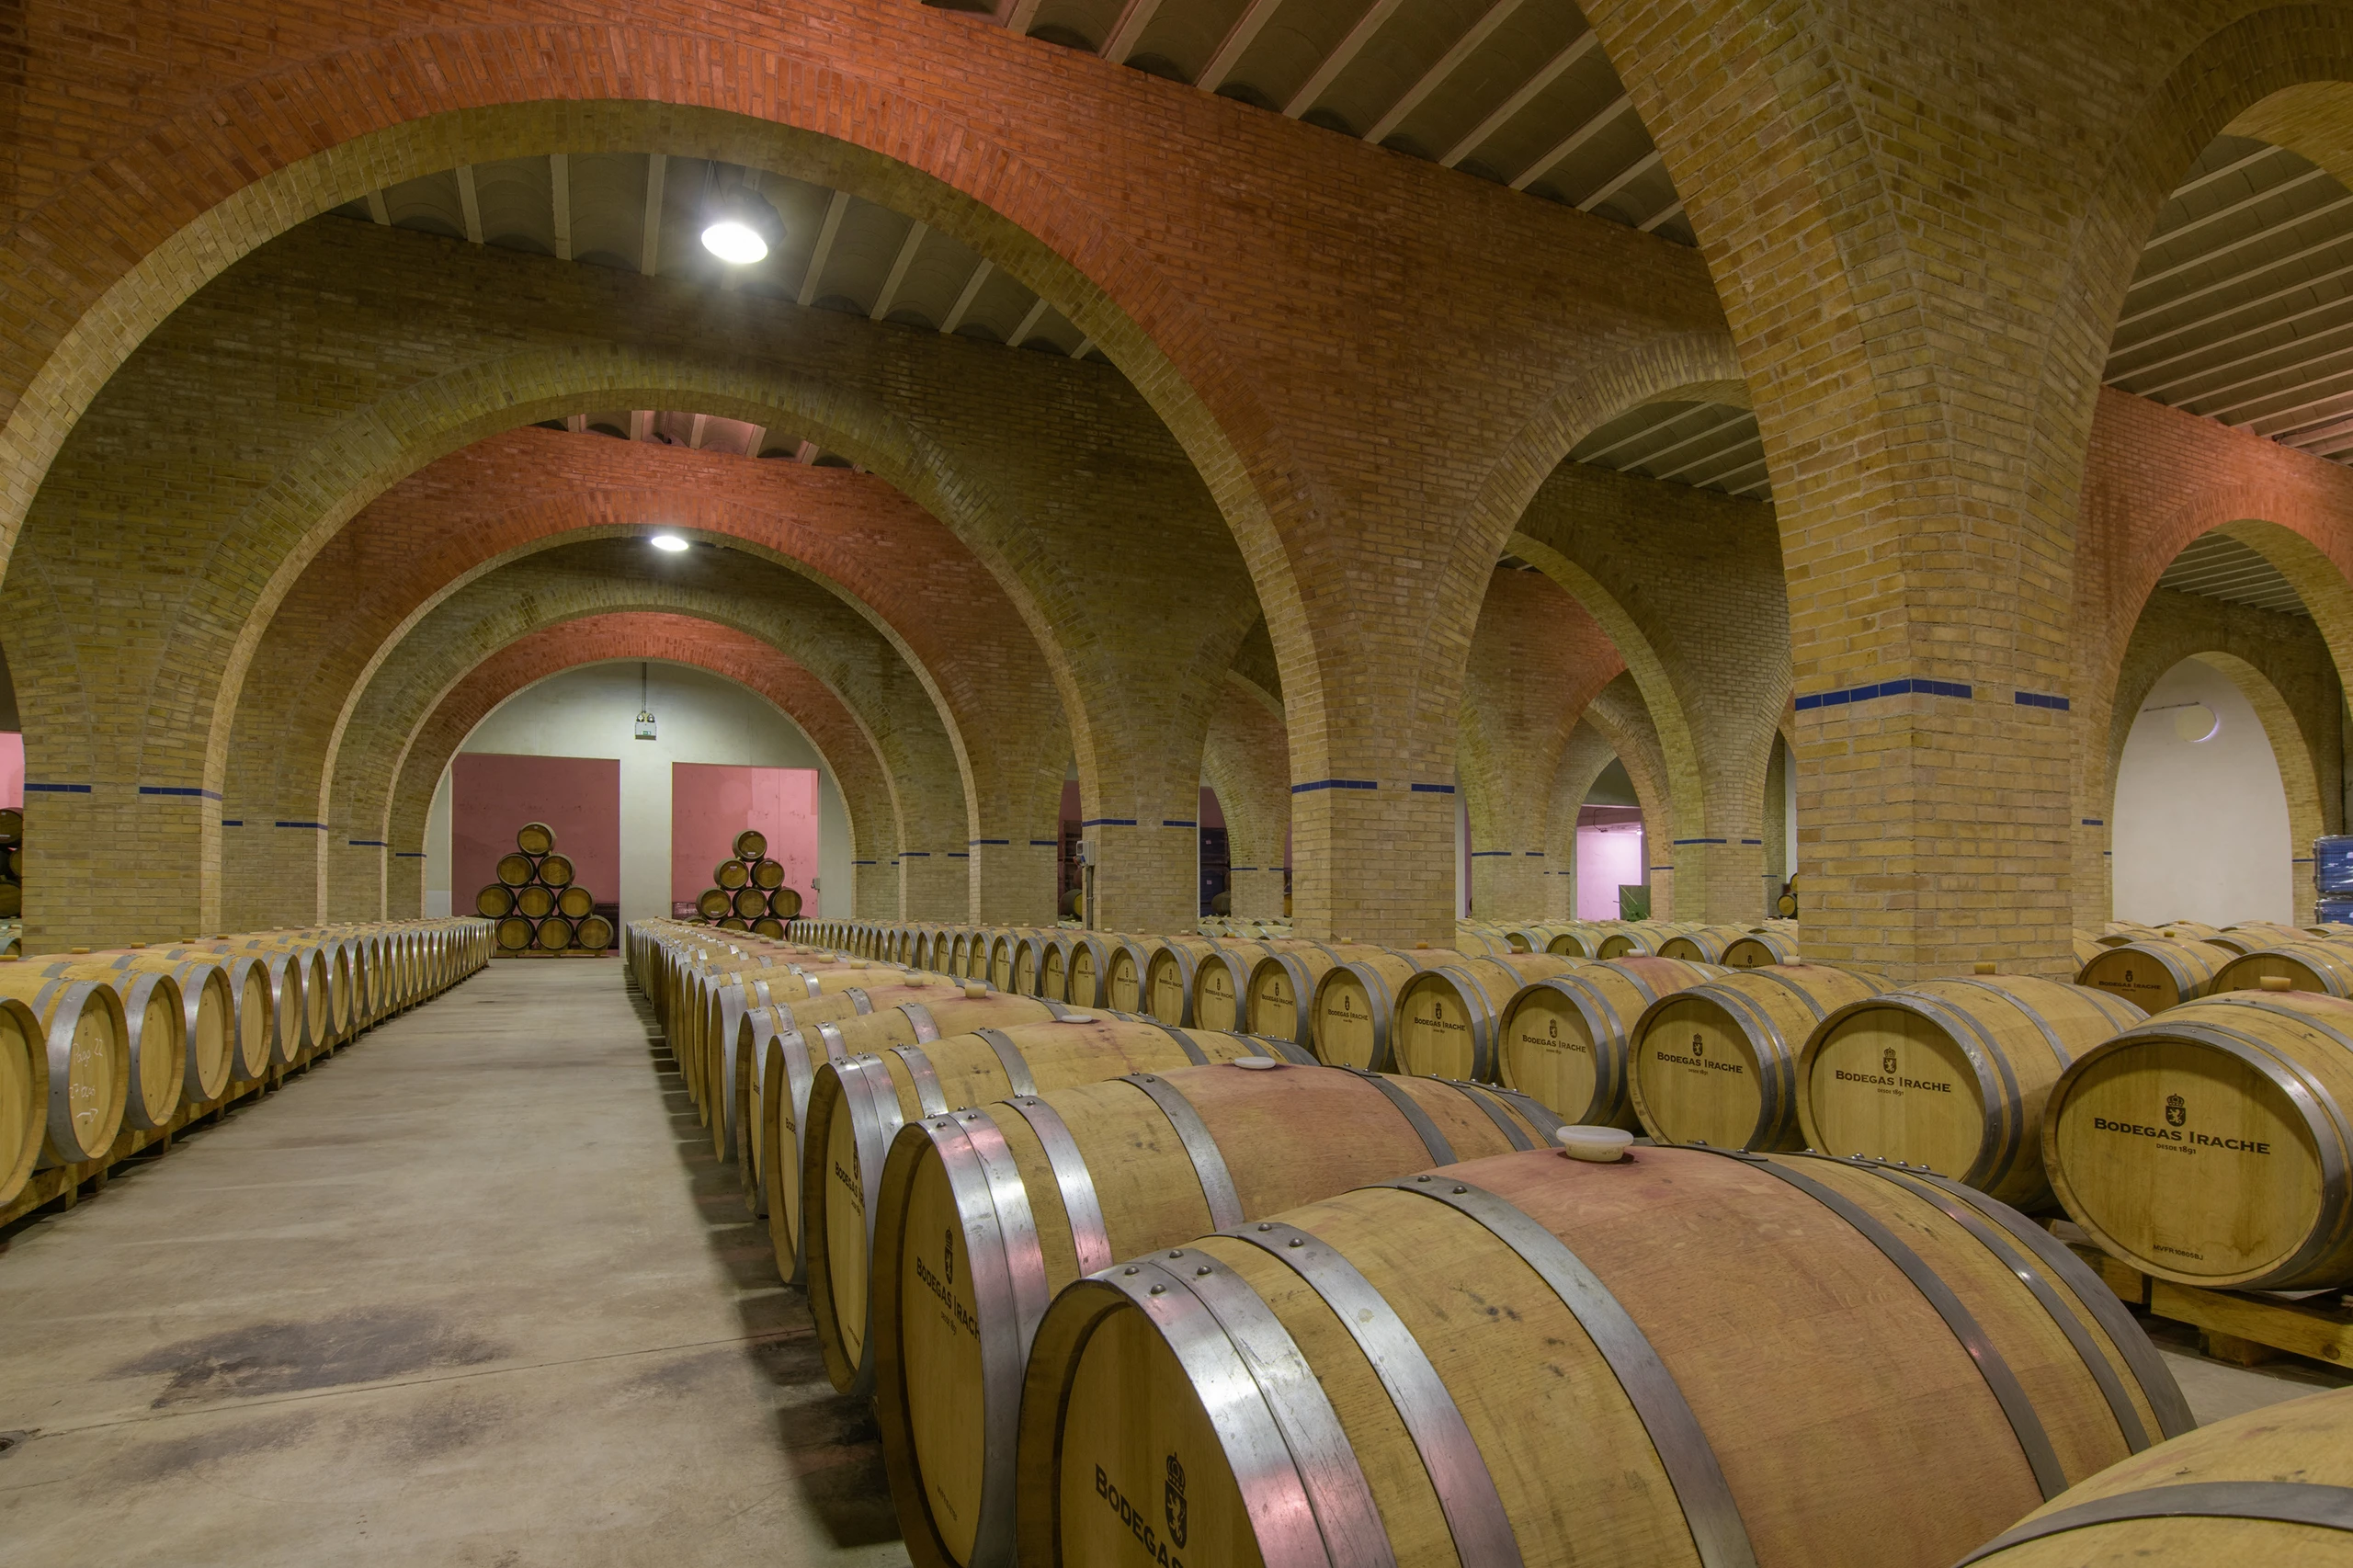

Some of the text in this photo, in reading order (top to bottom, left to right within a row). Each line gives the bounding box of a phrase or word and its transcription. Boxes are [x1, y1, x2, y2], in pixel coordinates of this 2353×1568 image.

[1328, 1009, 1369, 1021] BODEGAS IRACHE
[1415, 1017, 1465, 1031] BODEGAS IRACHE
[1522, 1034, 1556, 1048] BODEGAS
[1559, 1040, 1586, 1053] IRACHE
[1656, 1051, 1743, 1074] BODEGAS IRACHE
[1836, 1070, 1951, 1093] BODEGAS IRACHE
[2094, 1117, 2271, 1155] BODEGAS IRACHE
[2156, 1143, 2197, 1155] DESDE 1891
[916, 1256, 981, 1343] BODEGAS IRACH
